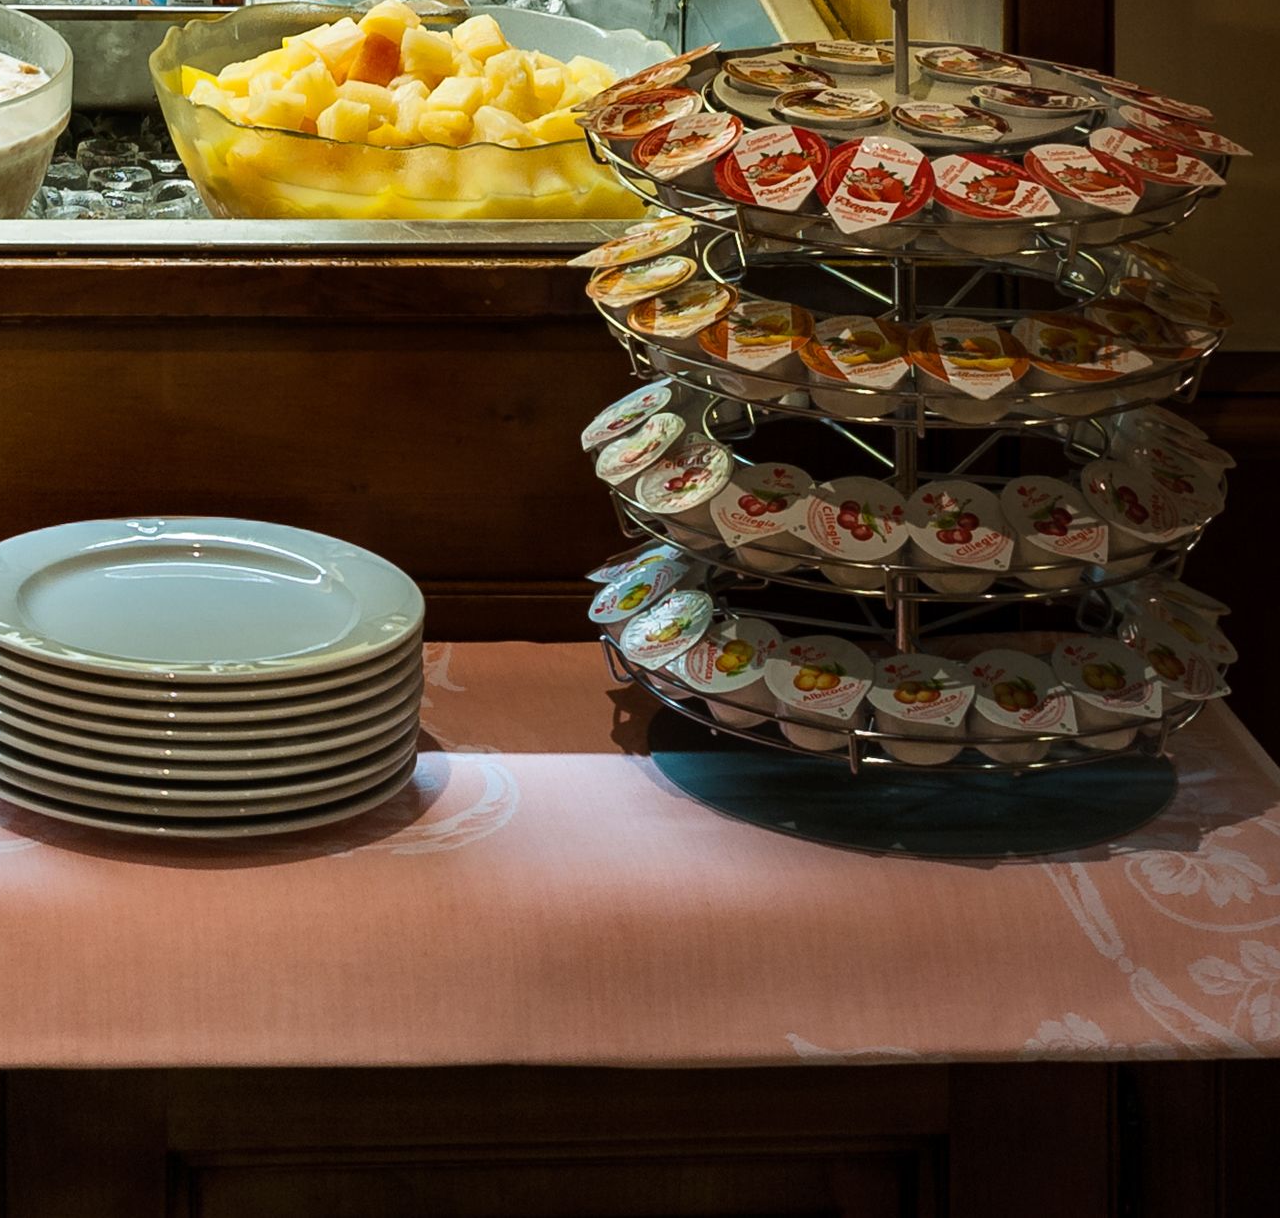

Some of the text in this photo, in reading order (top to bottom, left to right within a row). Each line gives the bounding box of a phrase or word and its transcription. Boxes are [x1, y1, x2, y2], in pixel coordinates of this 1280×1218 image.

[731, 512, 776, 528] Ciliegia
[822, 506, 842, 547] Ciliegia
[956, 532, 1000, 557] Ciliegia
[802, 682, 857, 702] Albicocca
[905, 694, 958, 714] Albicocca
